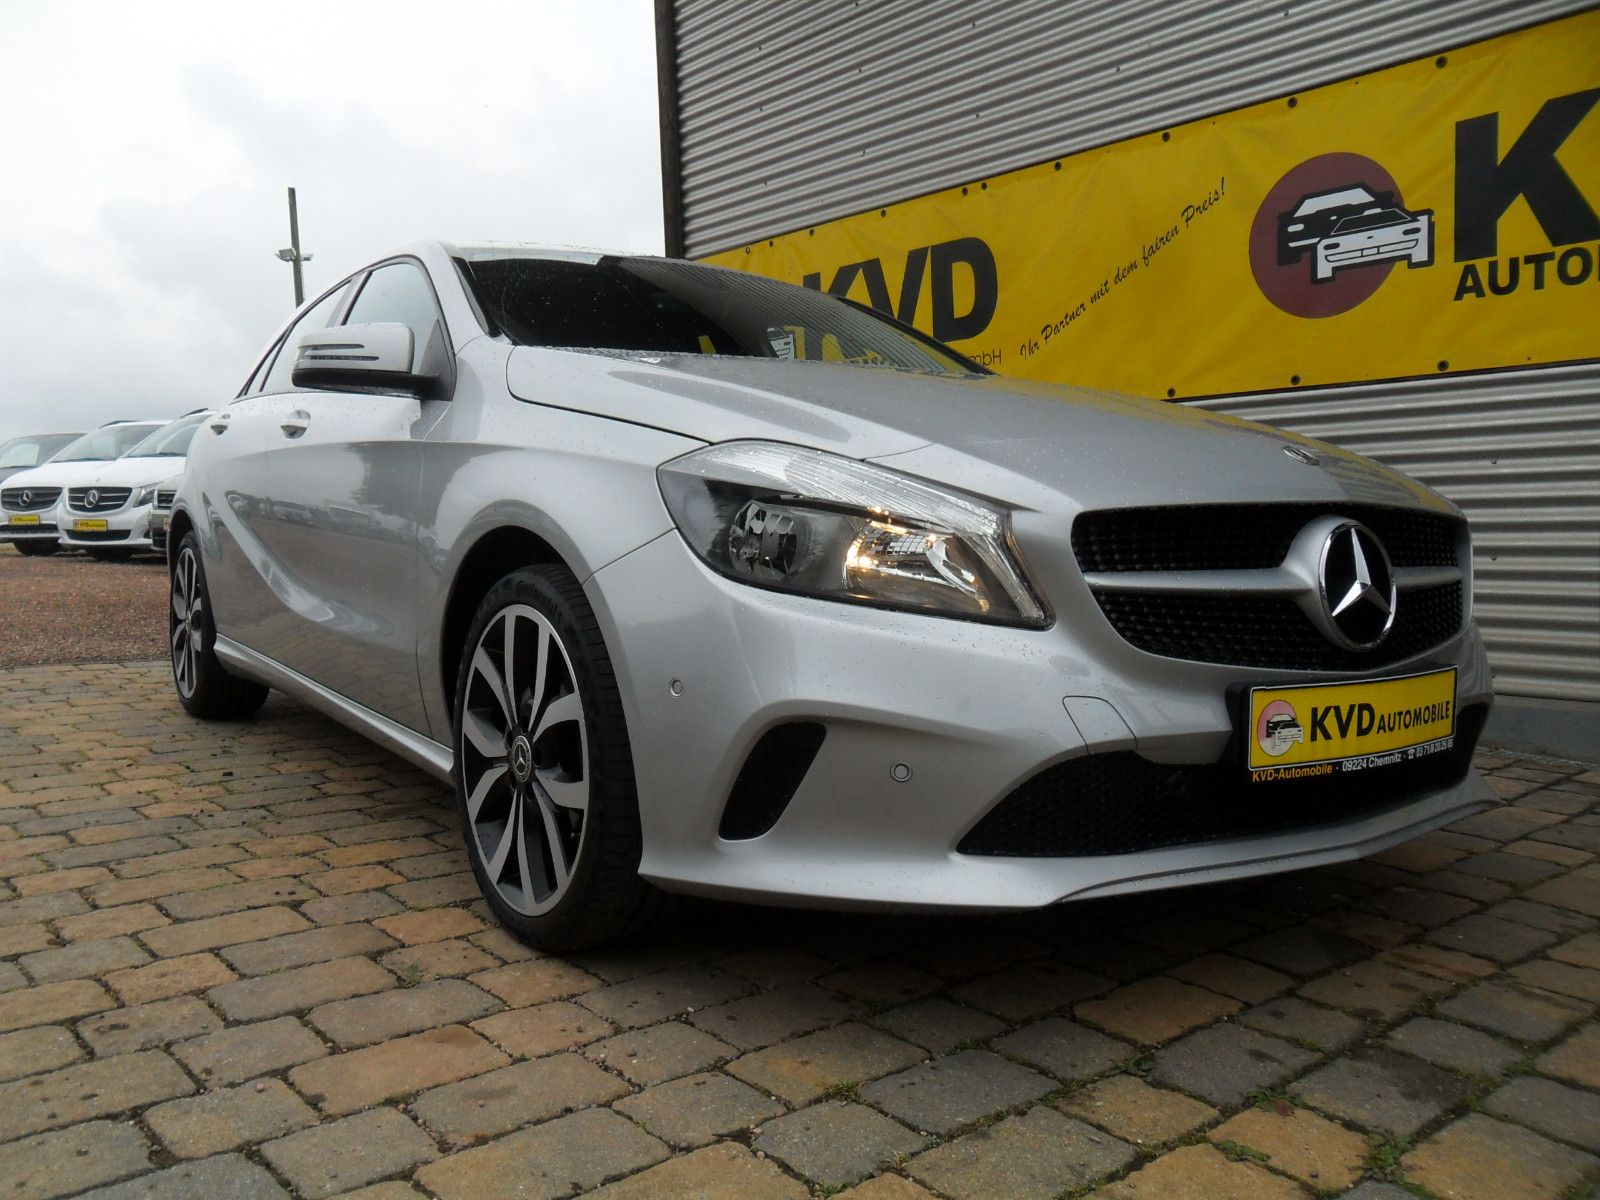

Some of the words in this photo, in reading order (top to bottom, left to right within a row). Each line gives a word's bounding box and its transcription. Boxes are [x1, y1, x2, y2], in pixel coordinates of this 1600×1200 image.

[1020, 340, 1039, 360] Ihr
[1041, 303, 1087, 345] Partner
[1090, 279, 1110, 304] mit
[1114, 260, 1138, 285] dem
[1142, 225, 1180, 267] fairen
[1181, 176, 1225, 229] Preis!
[1453, 244, 1600, 301] AUTO
[1310, 702, 1375, 742] KVD
[1376, 700, 1451, 735] AUTOMOBILE
[1252, 765, 1333, 782] KVD-Automobile
[1342, 757, 1367, 772] 09224
[1368, 753, 1402, 768] Chemnitz
